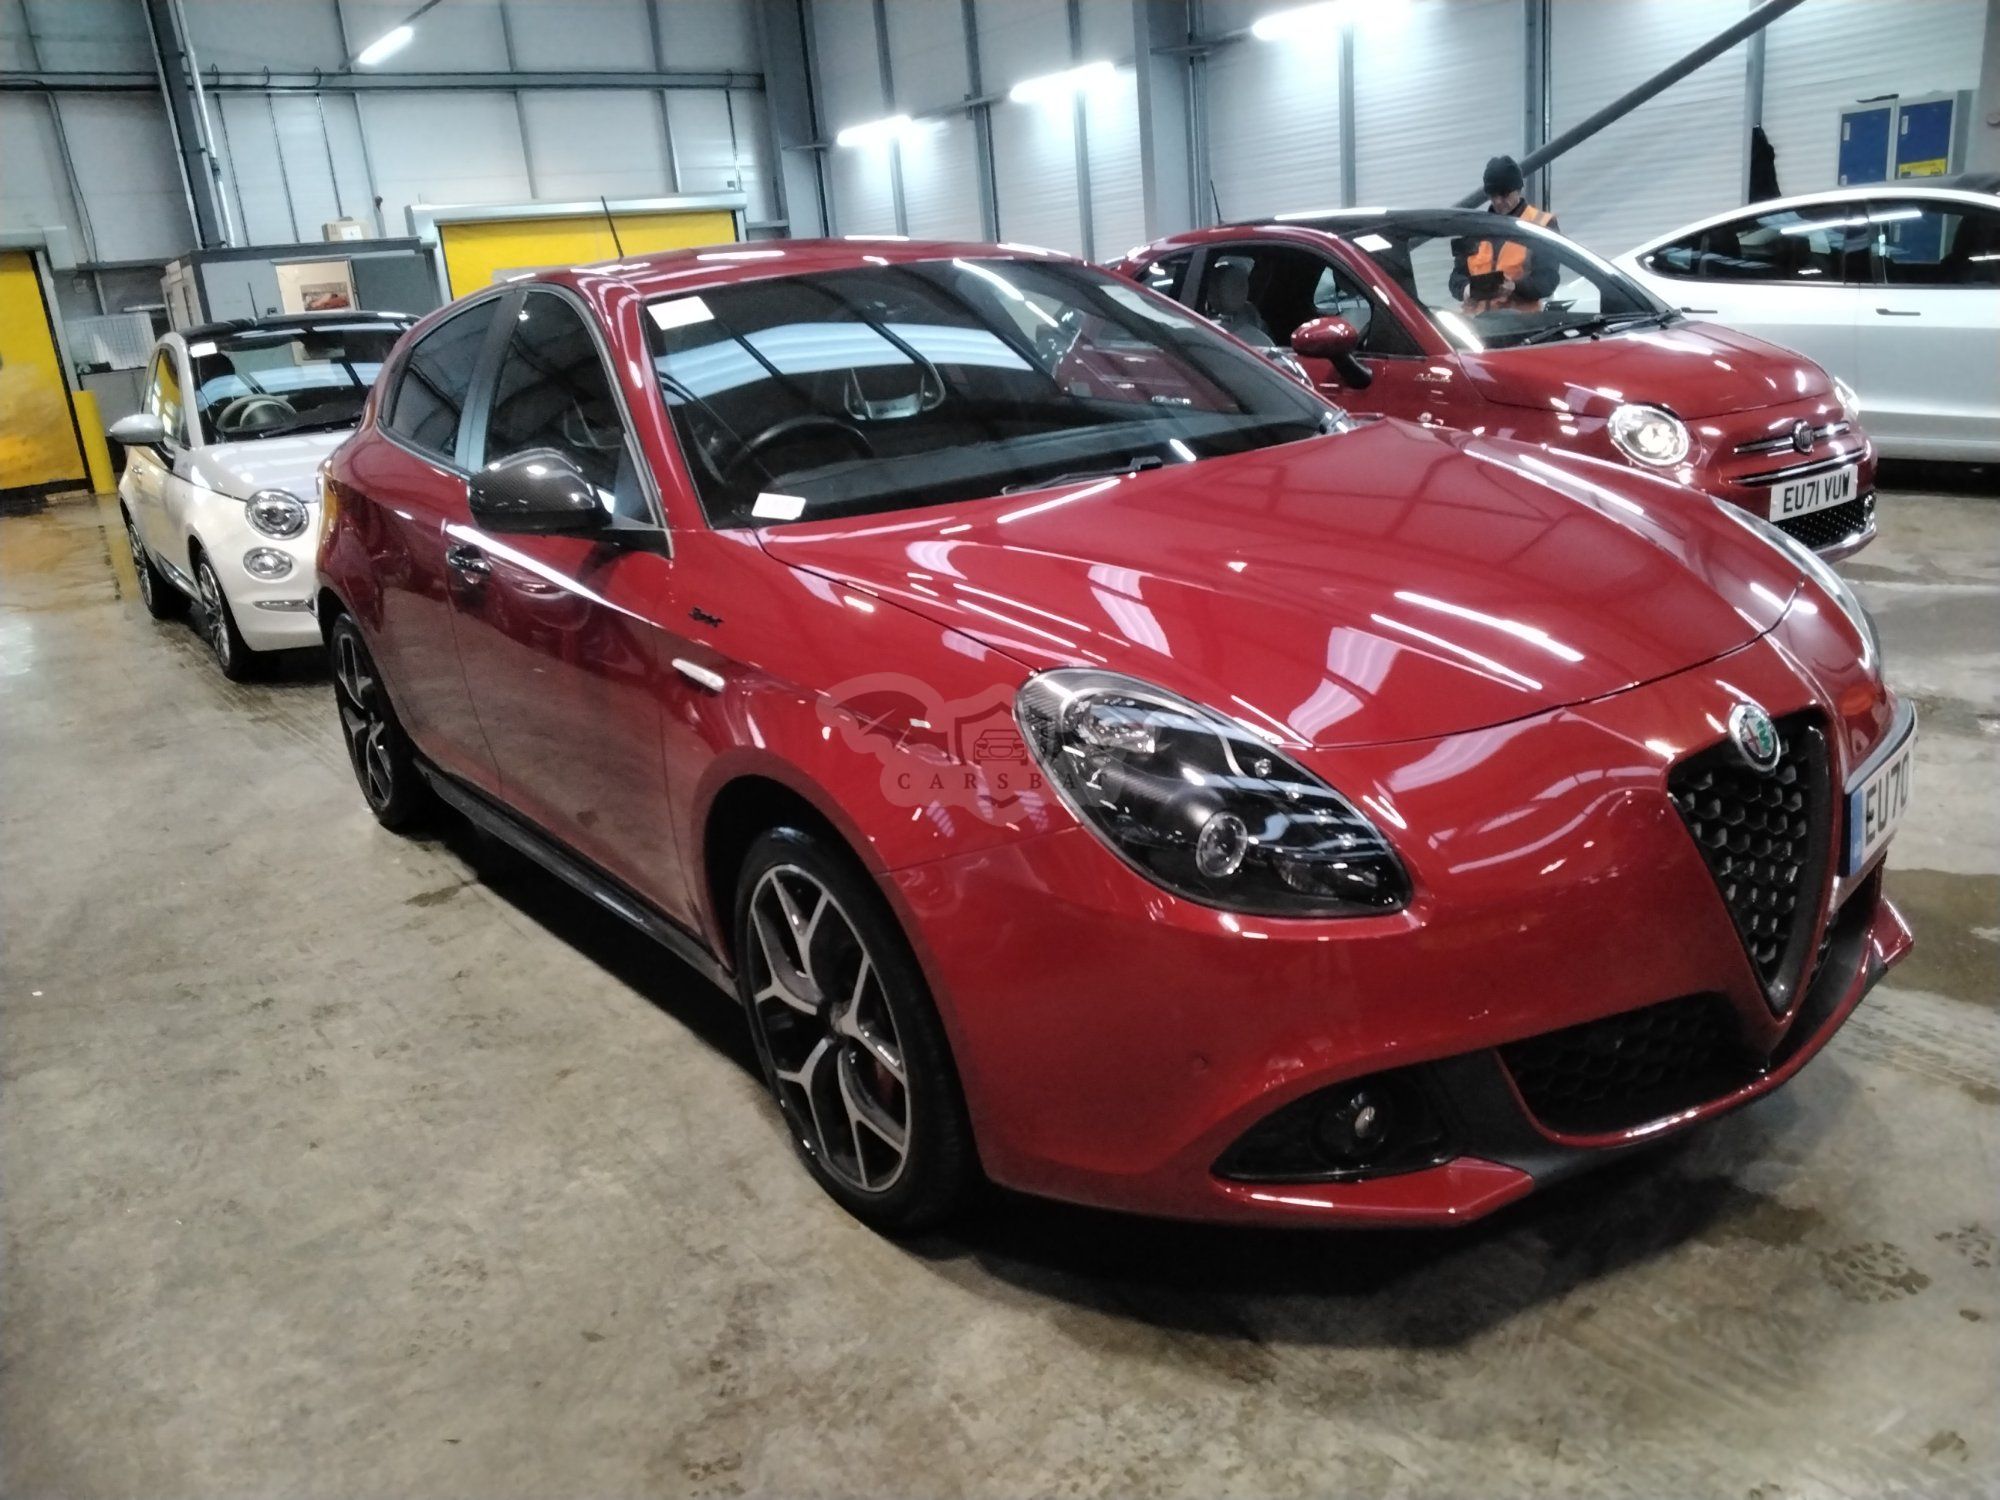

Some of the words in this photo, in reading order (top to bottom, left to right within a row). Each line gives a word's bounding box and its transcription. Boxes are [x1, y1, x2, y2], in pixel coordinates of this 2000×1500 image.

[1783, 480, 1820, 513] EU71
[1825, 471, 1850, 502] VUW
[1866, 751, 1909, 846] EU70
